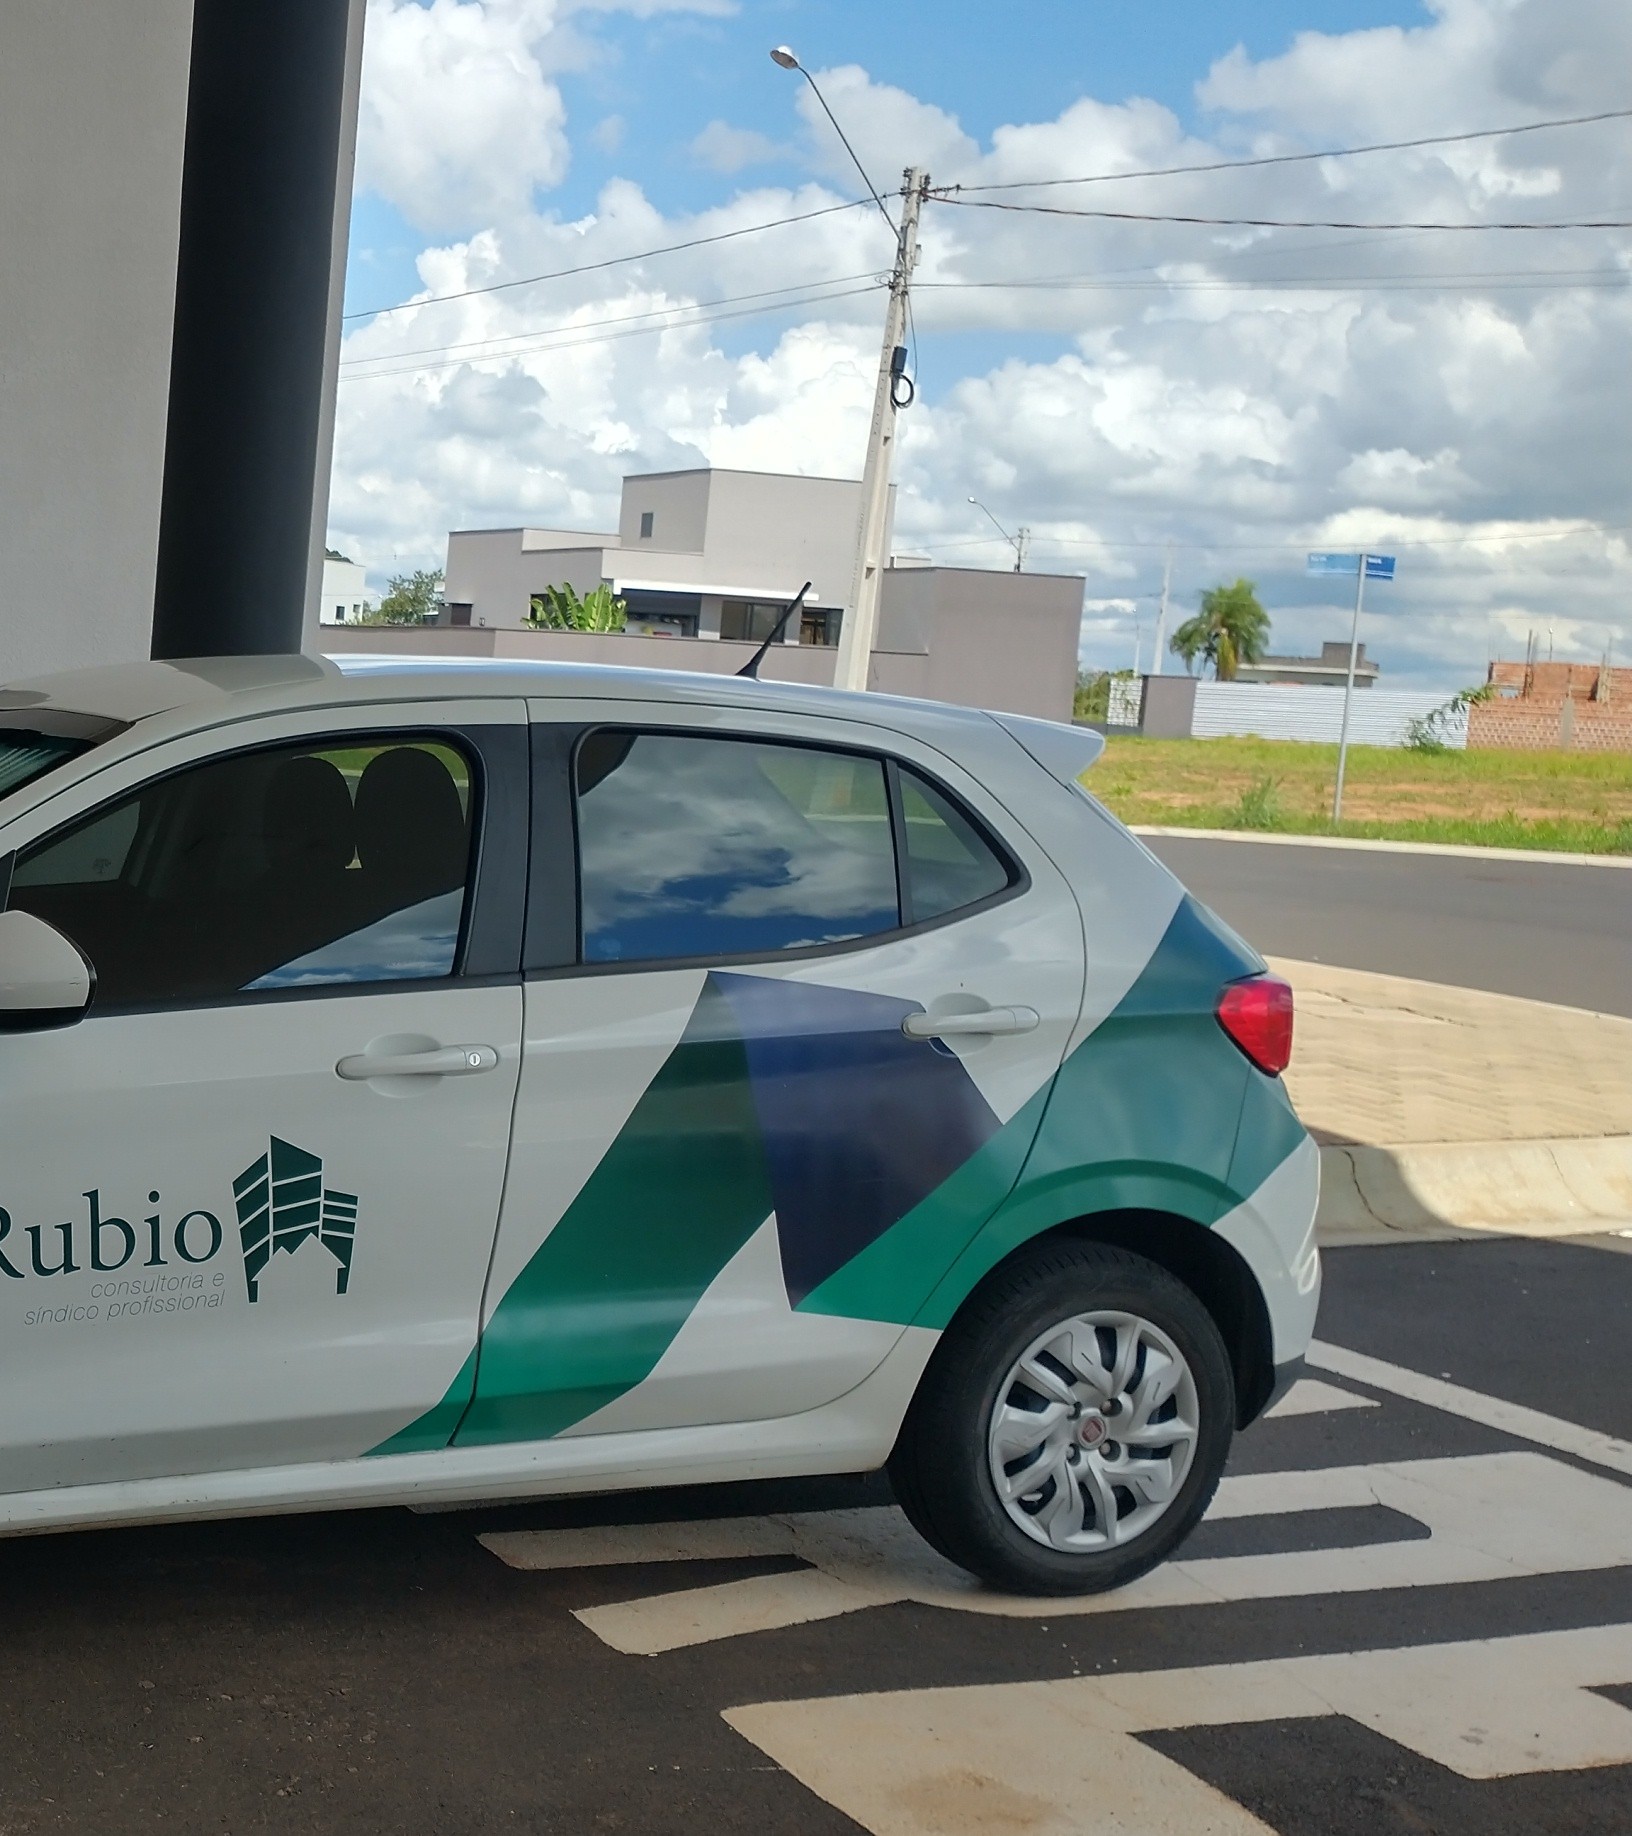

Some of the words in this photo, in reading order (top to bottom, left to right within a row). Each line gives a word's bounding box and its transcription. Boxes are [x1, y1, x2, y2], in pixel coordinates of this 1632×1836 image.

[90, 1271, 204, 1299] consultoria
[212, 1271, 225, 1287] e
[23, 1303, 100, 1326] síndico
[106, 1289, 226, 1322] profissional
